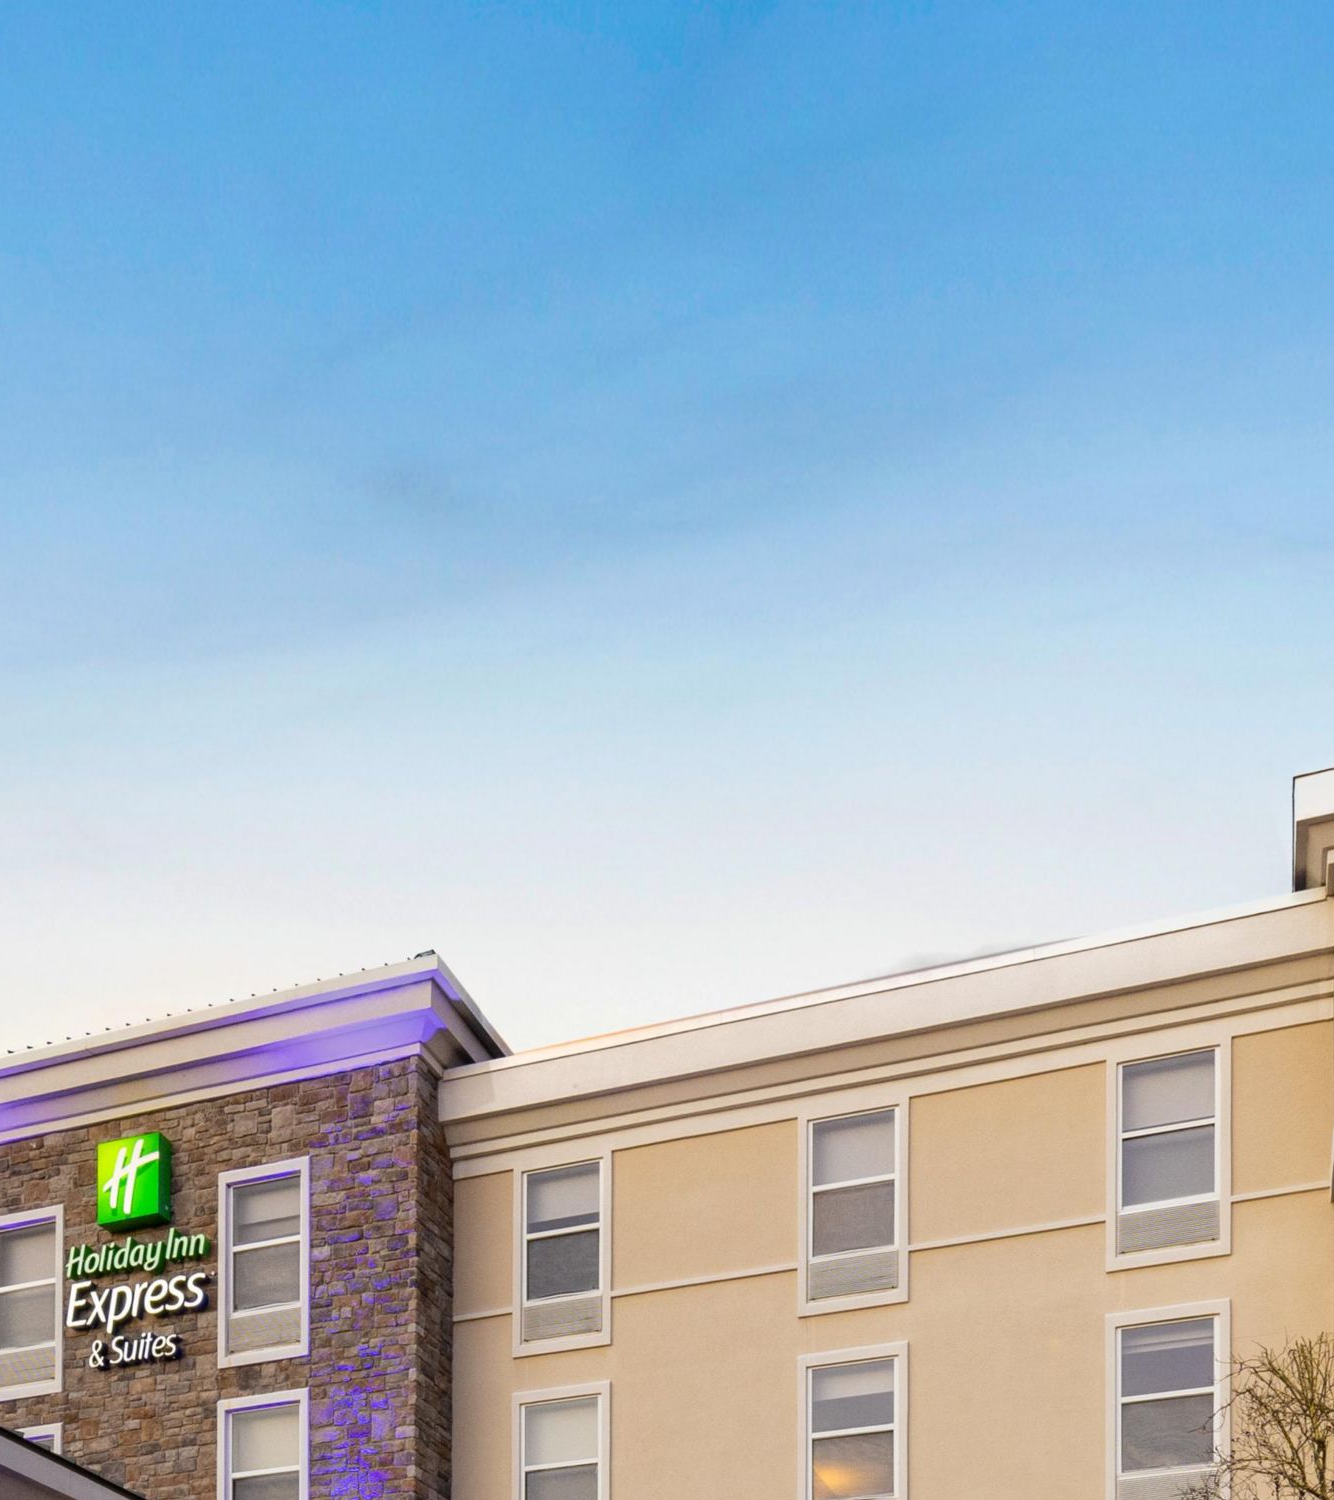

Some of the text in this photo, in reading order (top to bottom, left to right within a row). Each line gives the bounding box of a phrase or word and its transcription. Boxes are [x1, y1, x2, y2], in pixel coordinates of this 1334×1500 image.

[66, 1227, 206, 1278] Holiday Inn
[66, 1272, 207, 1334] Express
[89, 1332, 178, 1368] & Suites
